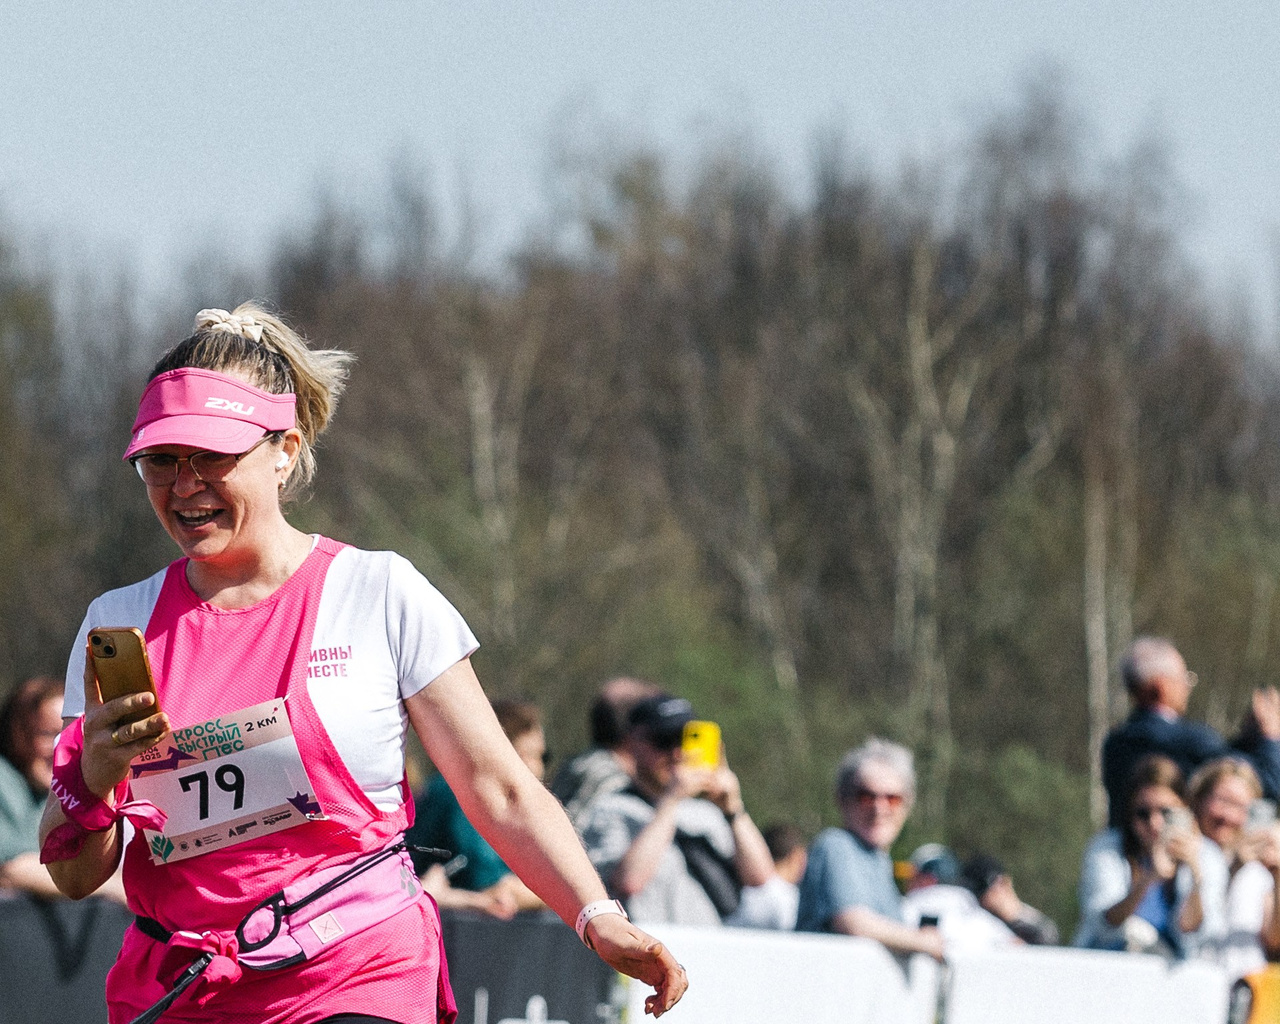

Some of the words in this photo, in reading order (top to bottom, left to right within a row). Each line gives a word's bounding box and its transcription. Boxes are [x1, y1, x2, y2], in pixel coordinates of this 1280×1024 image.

[204, 397, 255, 415] 2XU
[173, 719, 224, 743] КРОСС
[244, 722, 254, 732] 2
[177, 723, 242, 753] БЫСТРЫЙ
[140, 751, 162, 762] 2025
[178, 764, 245, 820] 79
